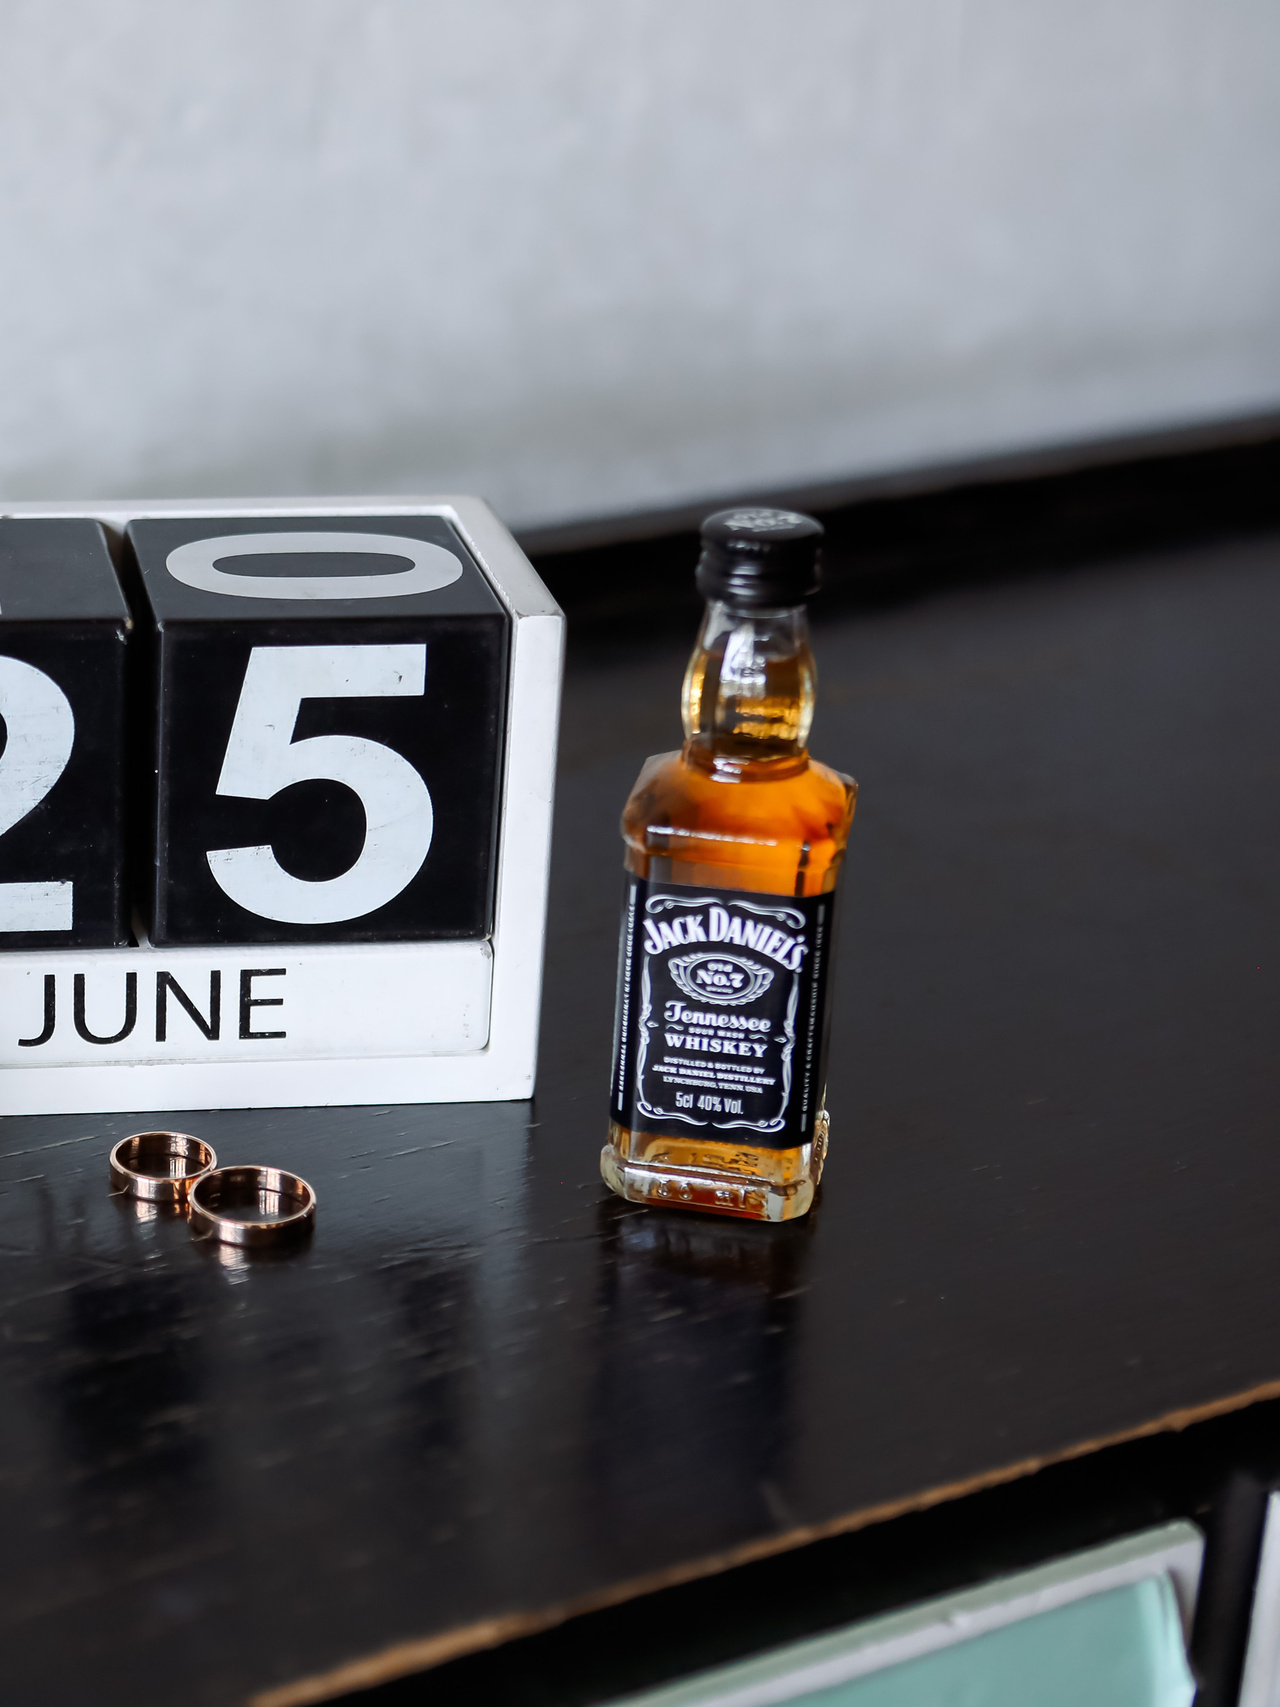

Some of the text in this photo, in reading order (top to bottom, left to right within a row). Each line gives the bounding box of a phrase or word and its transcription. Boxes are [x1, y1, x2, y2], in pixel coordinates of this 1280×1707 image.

[642, 914, 708, 955] JACK
[18, 967, 287, 1047] JUNE
[664, 1000, 771, 1032] Tennessee
[664, 1033, 768, 1057] WHISKEY
[652, 1064, 776, 1086] JACK DANIEL DISTILLERY
[663, 1056, 707, 1068] DISTILLED
[715, 1062, 753, 1074] BOTTLED
[753, 1067, 766, 1075] BY
[697, 1095, 722, 1112] 40%
[723, 1098, 745, 1115] Vol.
